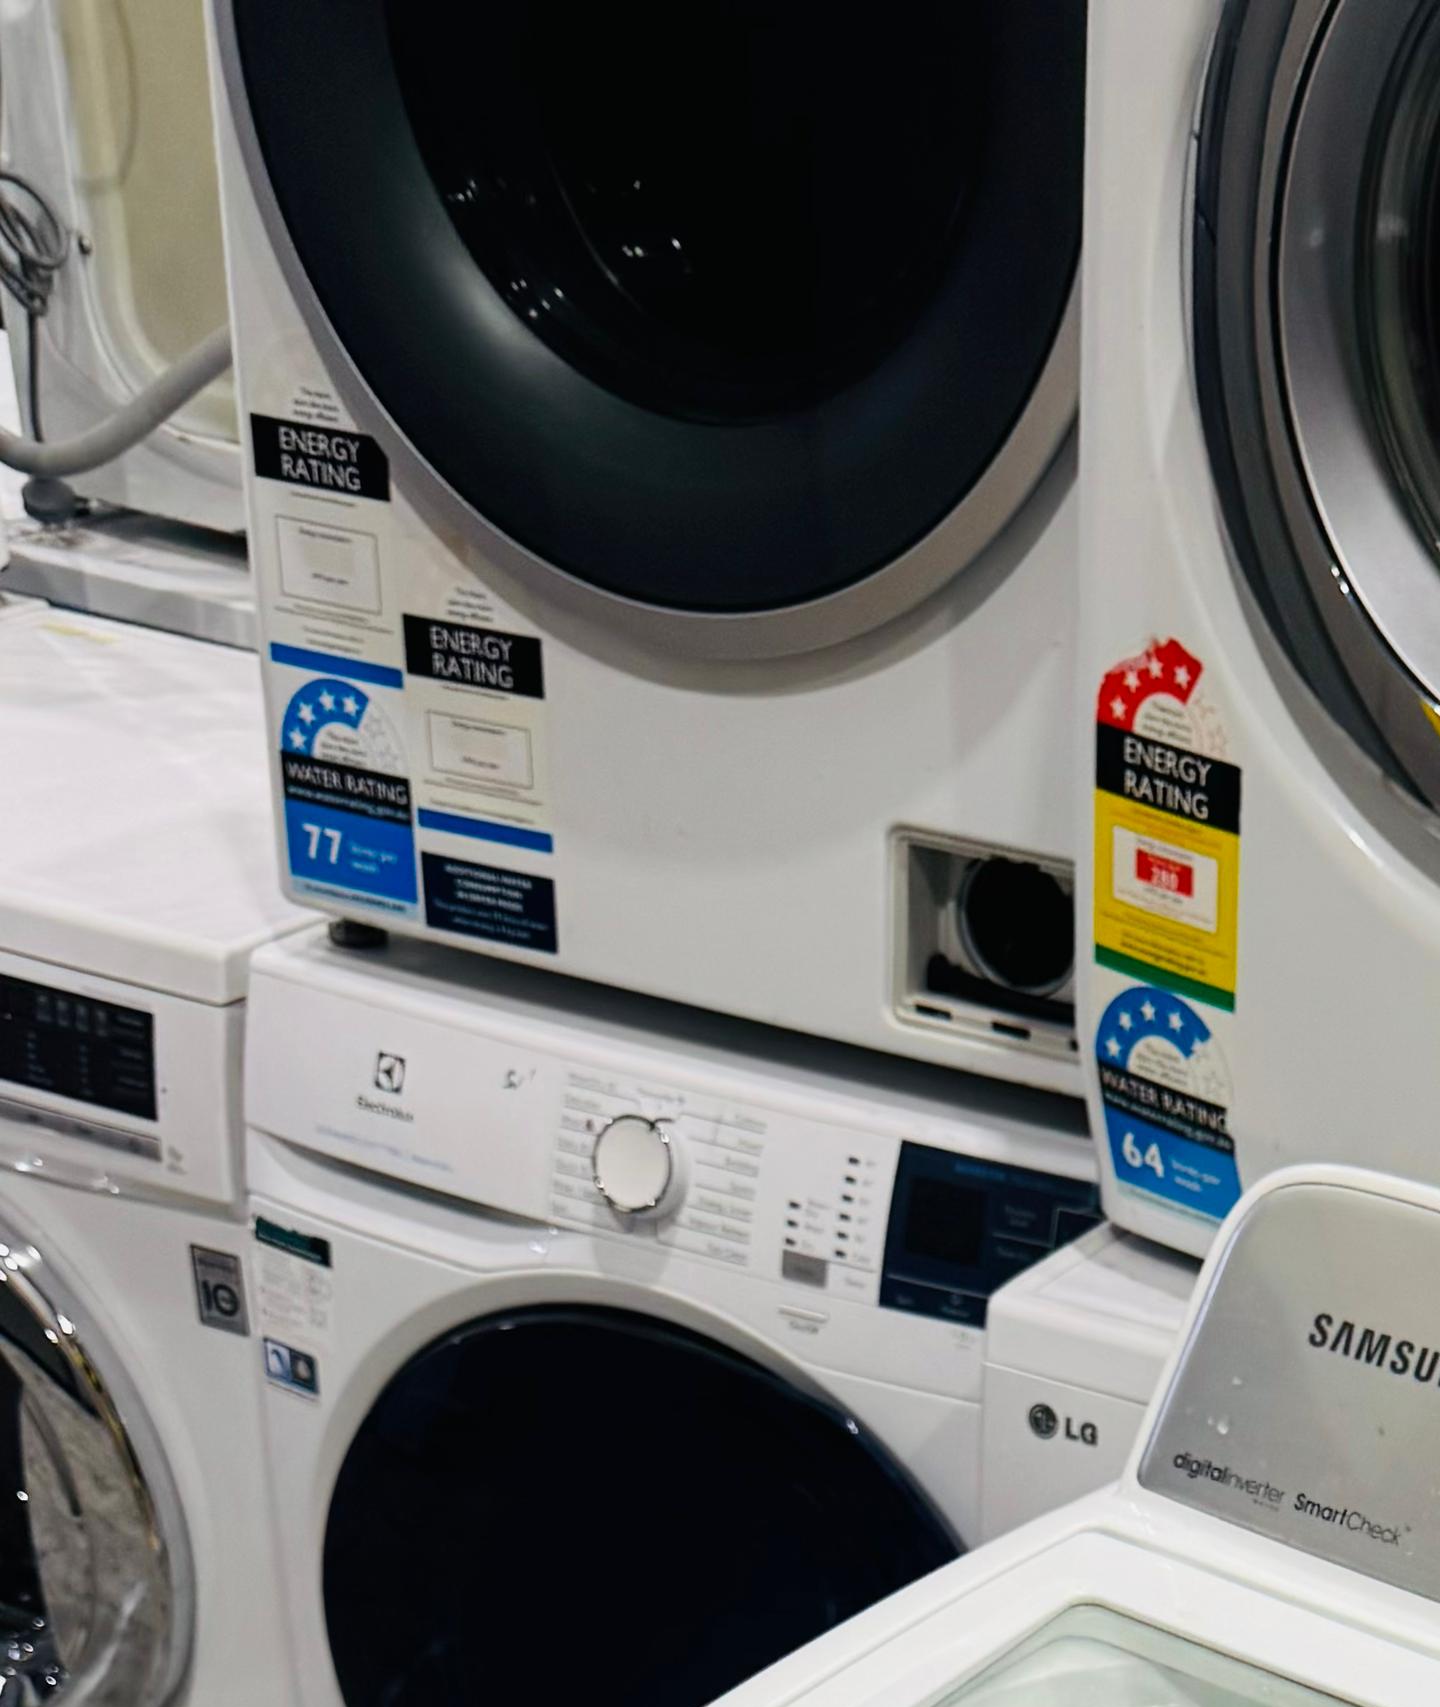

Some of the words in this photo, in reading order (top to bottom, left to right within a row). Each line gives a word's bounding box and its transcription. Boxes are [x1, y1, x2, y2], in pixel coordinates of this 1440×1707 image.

[278, 425, 361, 464] ENERGY
[280, 452, 362, 493] RATING
[430, 623, 513, 663] ENERGY
[432, 654, 514, 692] RATING
[1123, 736, 1213, 787] ENERGY
[287, 761, 343, 791] WATER
[346, 774, 409, 806] RATING
[1123, 769, 1210, 821] RATING
[302, 822, 343, 865] 77
[1102, 1066, 1158, 1104] WATER
[1121, 1131, 1165, 1178] 64
[1064, 1416, 1098, 1447] LG
